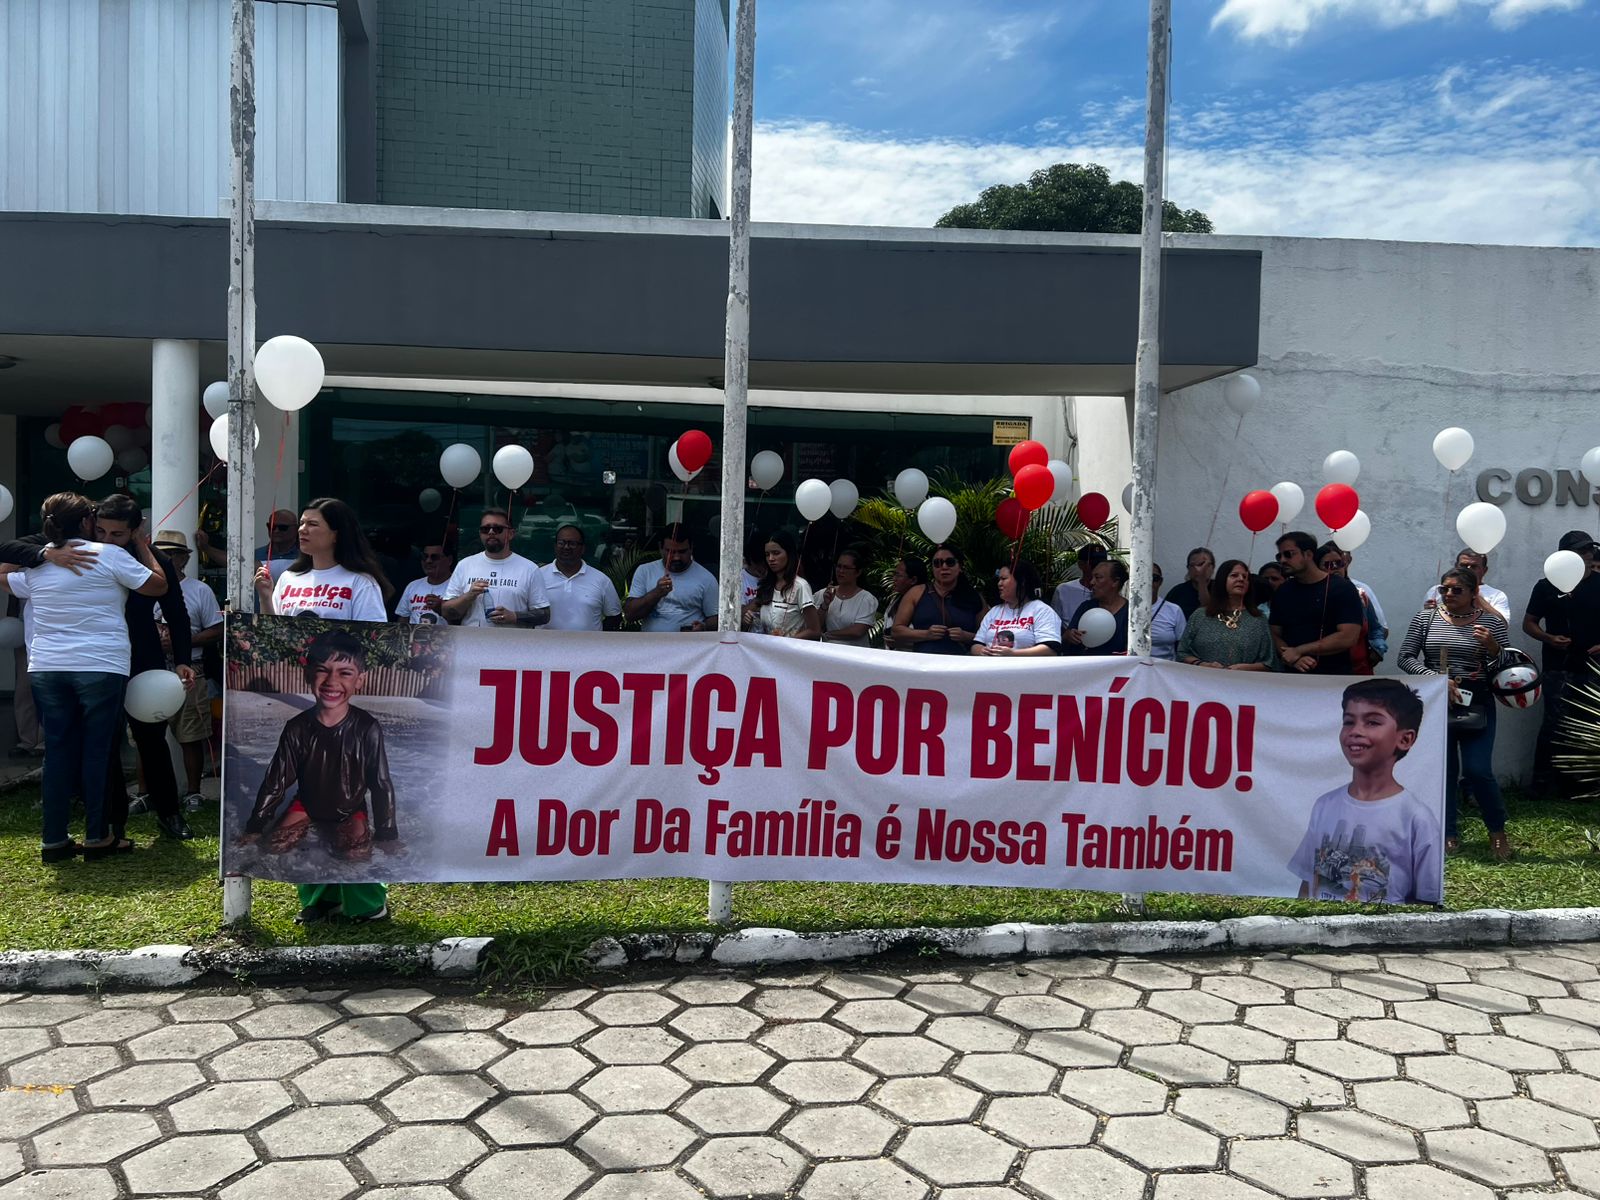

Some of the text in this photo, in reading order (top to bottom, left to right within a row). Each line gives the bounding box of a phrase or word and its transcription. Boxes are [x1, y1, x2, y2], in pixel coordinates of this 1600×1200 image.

[1476, 467, 1600, 507] CON
[281, 584, 352, 600] Justiça
[499, 578, 518, 587] EAGLE
[474, 669, 1256, 793] JUSTIÇA POR BENÍCIO!
[485, 799, 1234, 872] A Dor Da Família é Nossa Também
